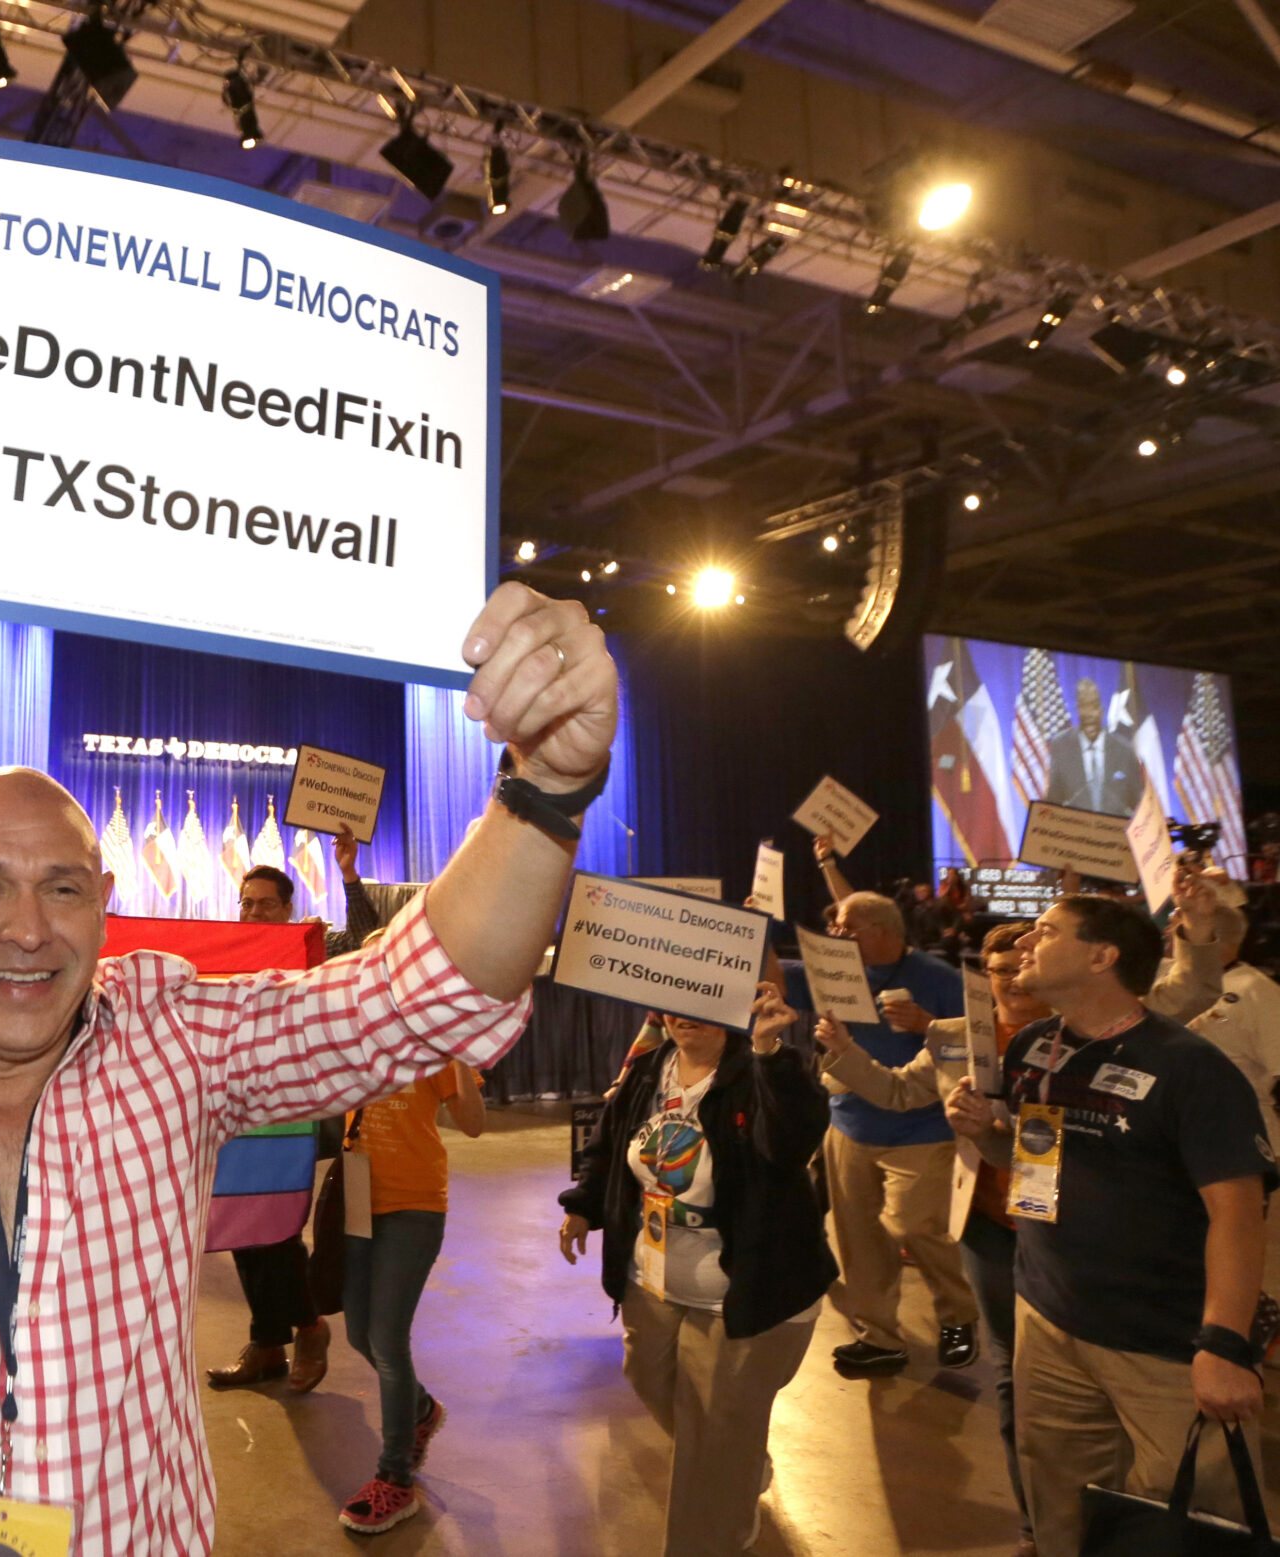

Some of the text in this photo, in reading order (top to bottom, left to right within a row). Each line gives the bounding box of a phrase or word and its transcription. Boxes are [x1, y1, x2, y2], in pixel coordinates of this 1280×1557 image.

[239, 248, 459, 356] DEMOCRATS
[83, 734, 298, 765] TEXAS DEMOCRA
[603, 893, 756, 940] STONEWALL DEMOCRATS
[573, 919, 752, 973] #WeDontNeedFixin
[589, 955, 724, 999] @TXStonewall
